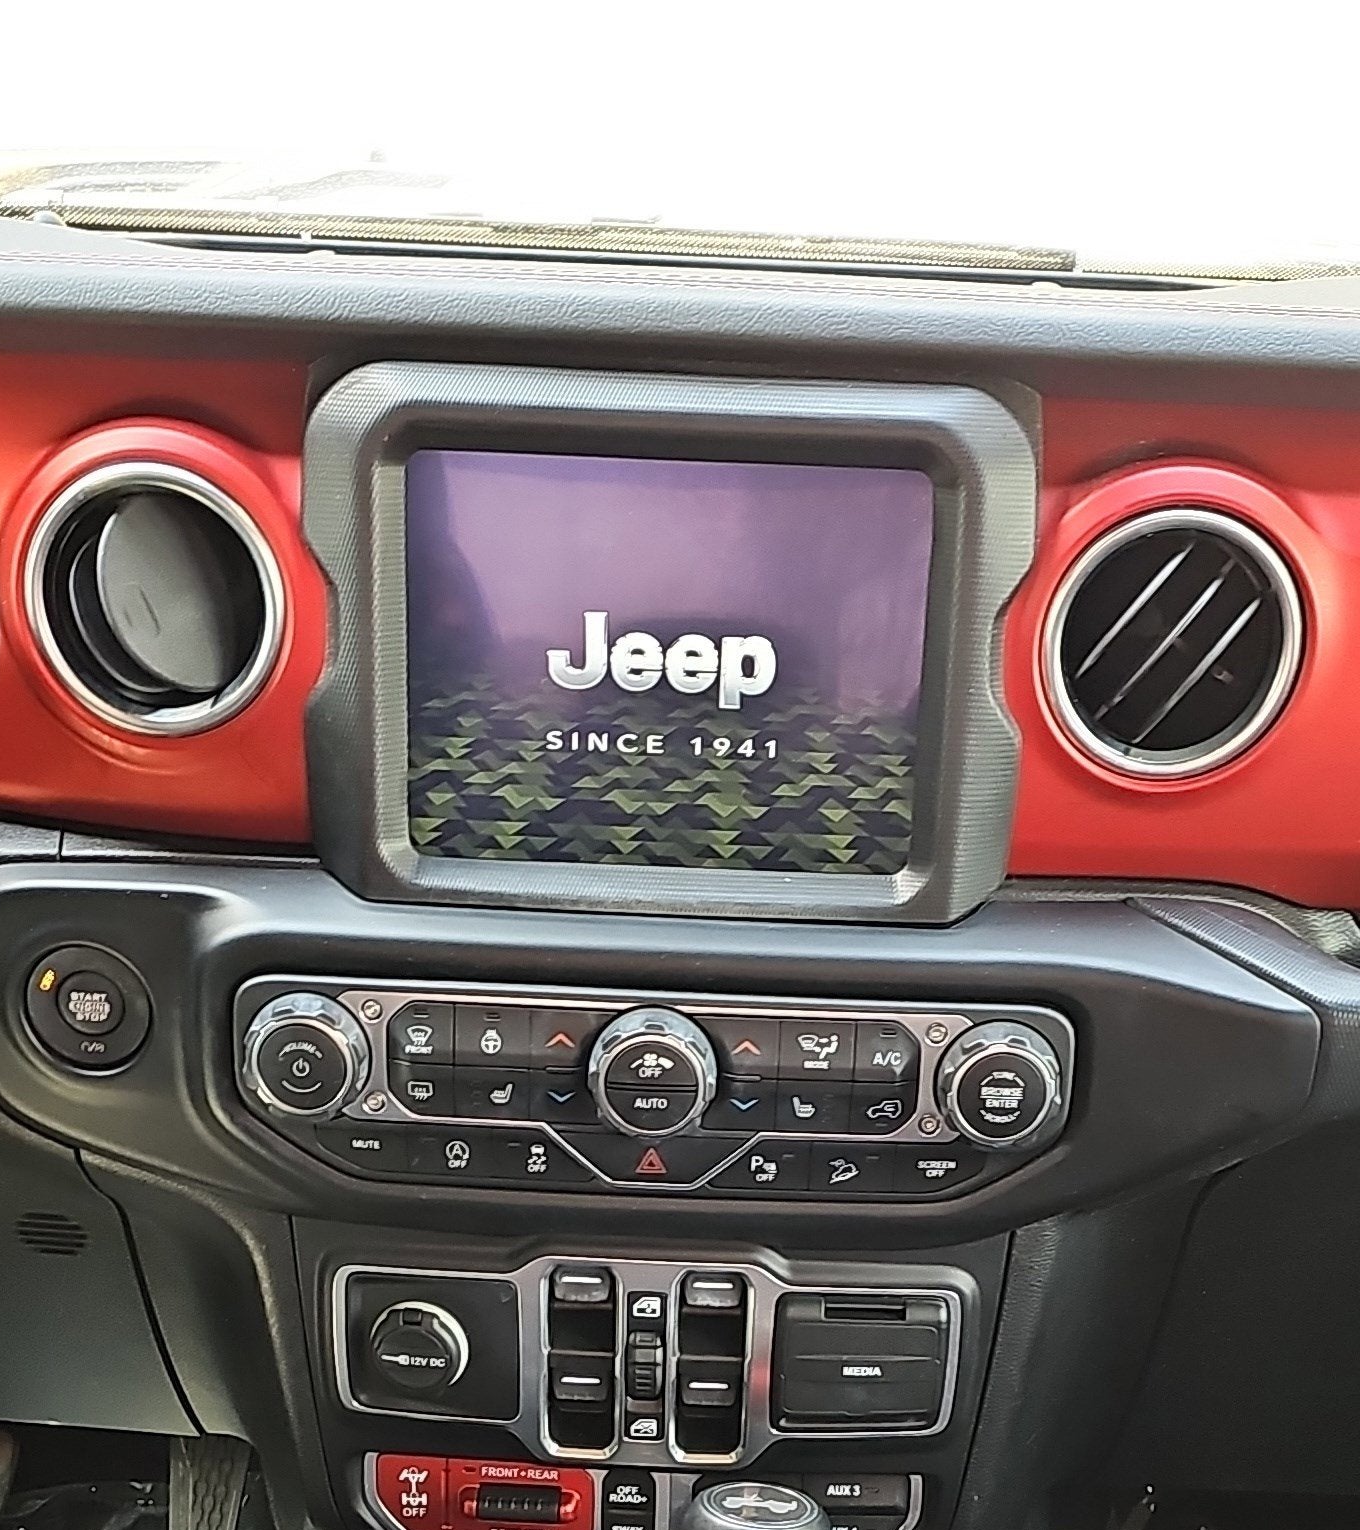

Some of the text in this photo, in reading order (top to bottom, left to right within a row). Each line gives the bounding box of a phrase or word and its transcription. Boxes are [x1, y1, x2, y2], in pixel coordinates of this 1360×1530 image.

[545, 610, 777, 710] Jeep
[545, 730, 778, 760] SINCE 1941
[872, 1051, 903, 1067] A/C
[638, 1066, 663, 1079] OFF
[980, 1086, 1024, 1097] BROWSE
[633, 1097, 668, 1110] AUTO
[985, 1098, 1019, 1109] ENTER
[351, 1138, 381, 1150] MUTE
[447, 1159, 468, 1169] OFF
[527, 1163, 547, 1174] OFF
[917, 1160, 957, 1169] SCREEN
[755, 1173, 777, 1183] OFF
[925, 1169, 946, 1178] OFF
[410, 1355, 446, 1368] 12V DC
[842, 1366, 882, 1377] MEDIA
[616, 1485, 640, 1495] OFF
[827, 1484, 862, 1497] AUX 3
[402, 1507, 427, 1518] OFF
